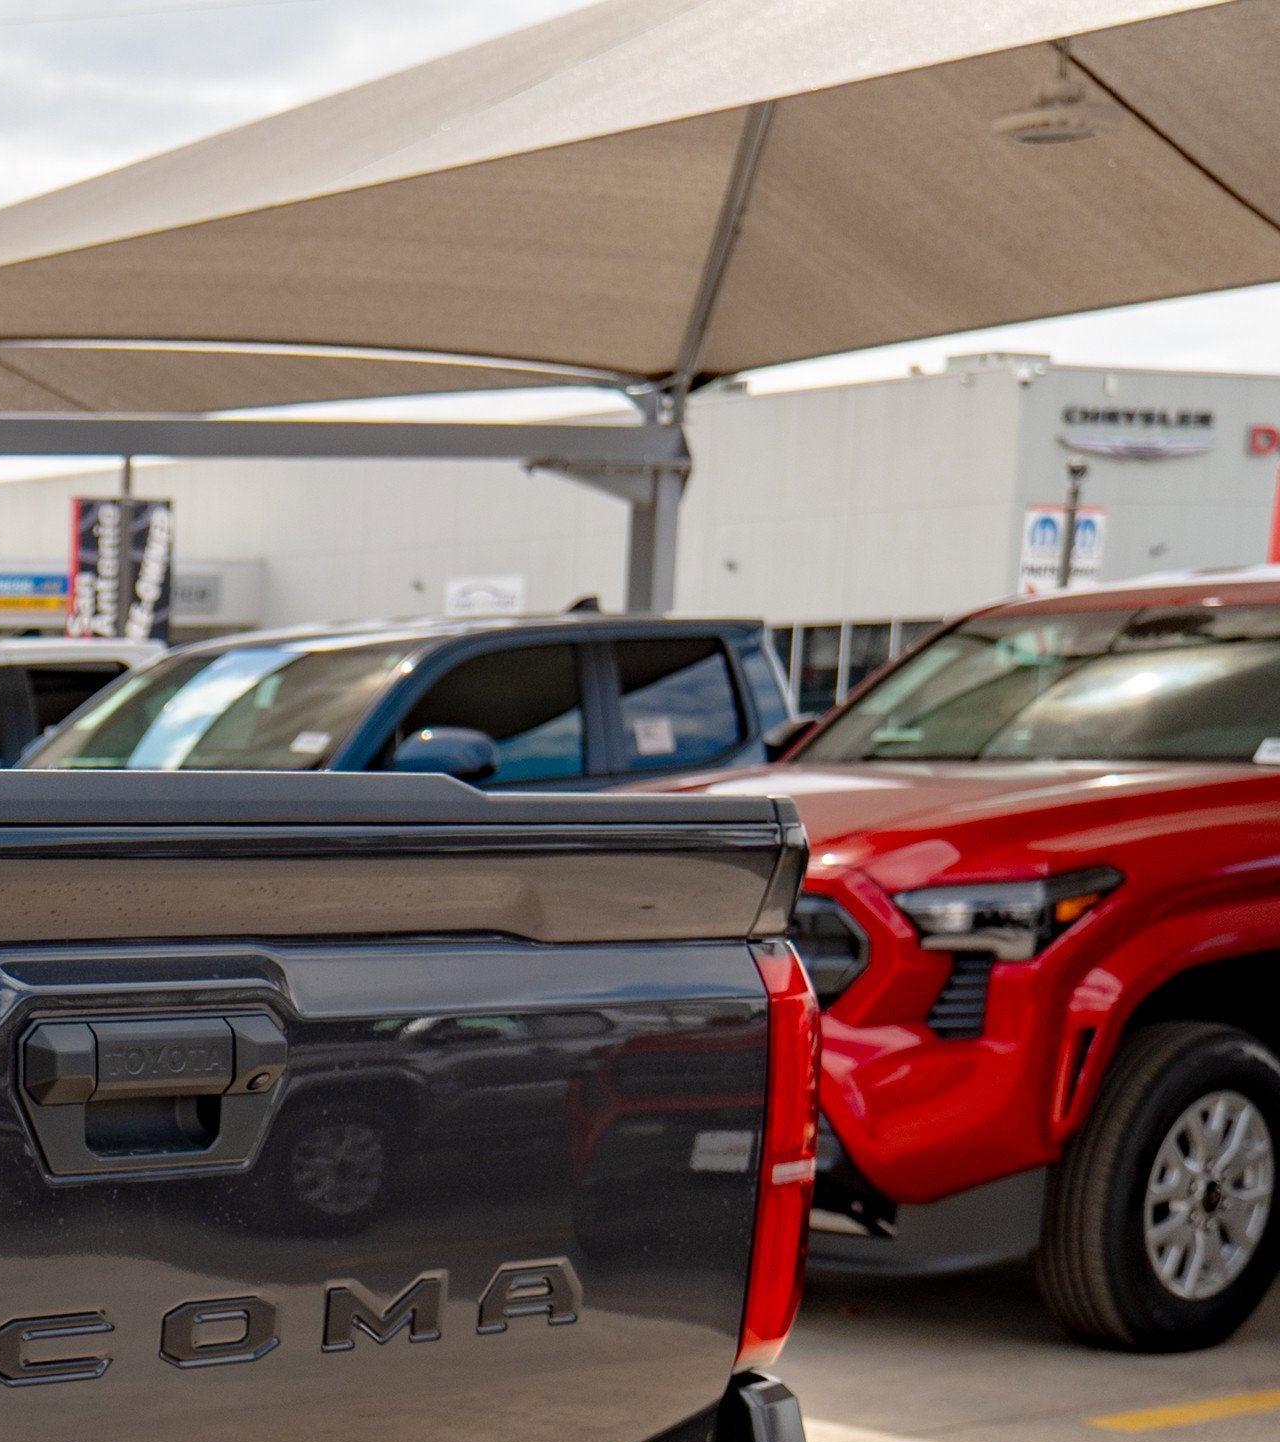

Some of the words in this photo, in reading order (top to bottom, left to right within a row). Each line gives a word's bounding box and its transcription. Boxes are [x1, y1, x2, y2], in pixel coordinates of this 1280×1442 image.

[1062, 406, 1214, 427] CHRYSLER
[91, 503, 121, 638] Antonio
[67, 573, 96, 638] San
[104, 1044, 227, 1076] TOYOTA
